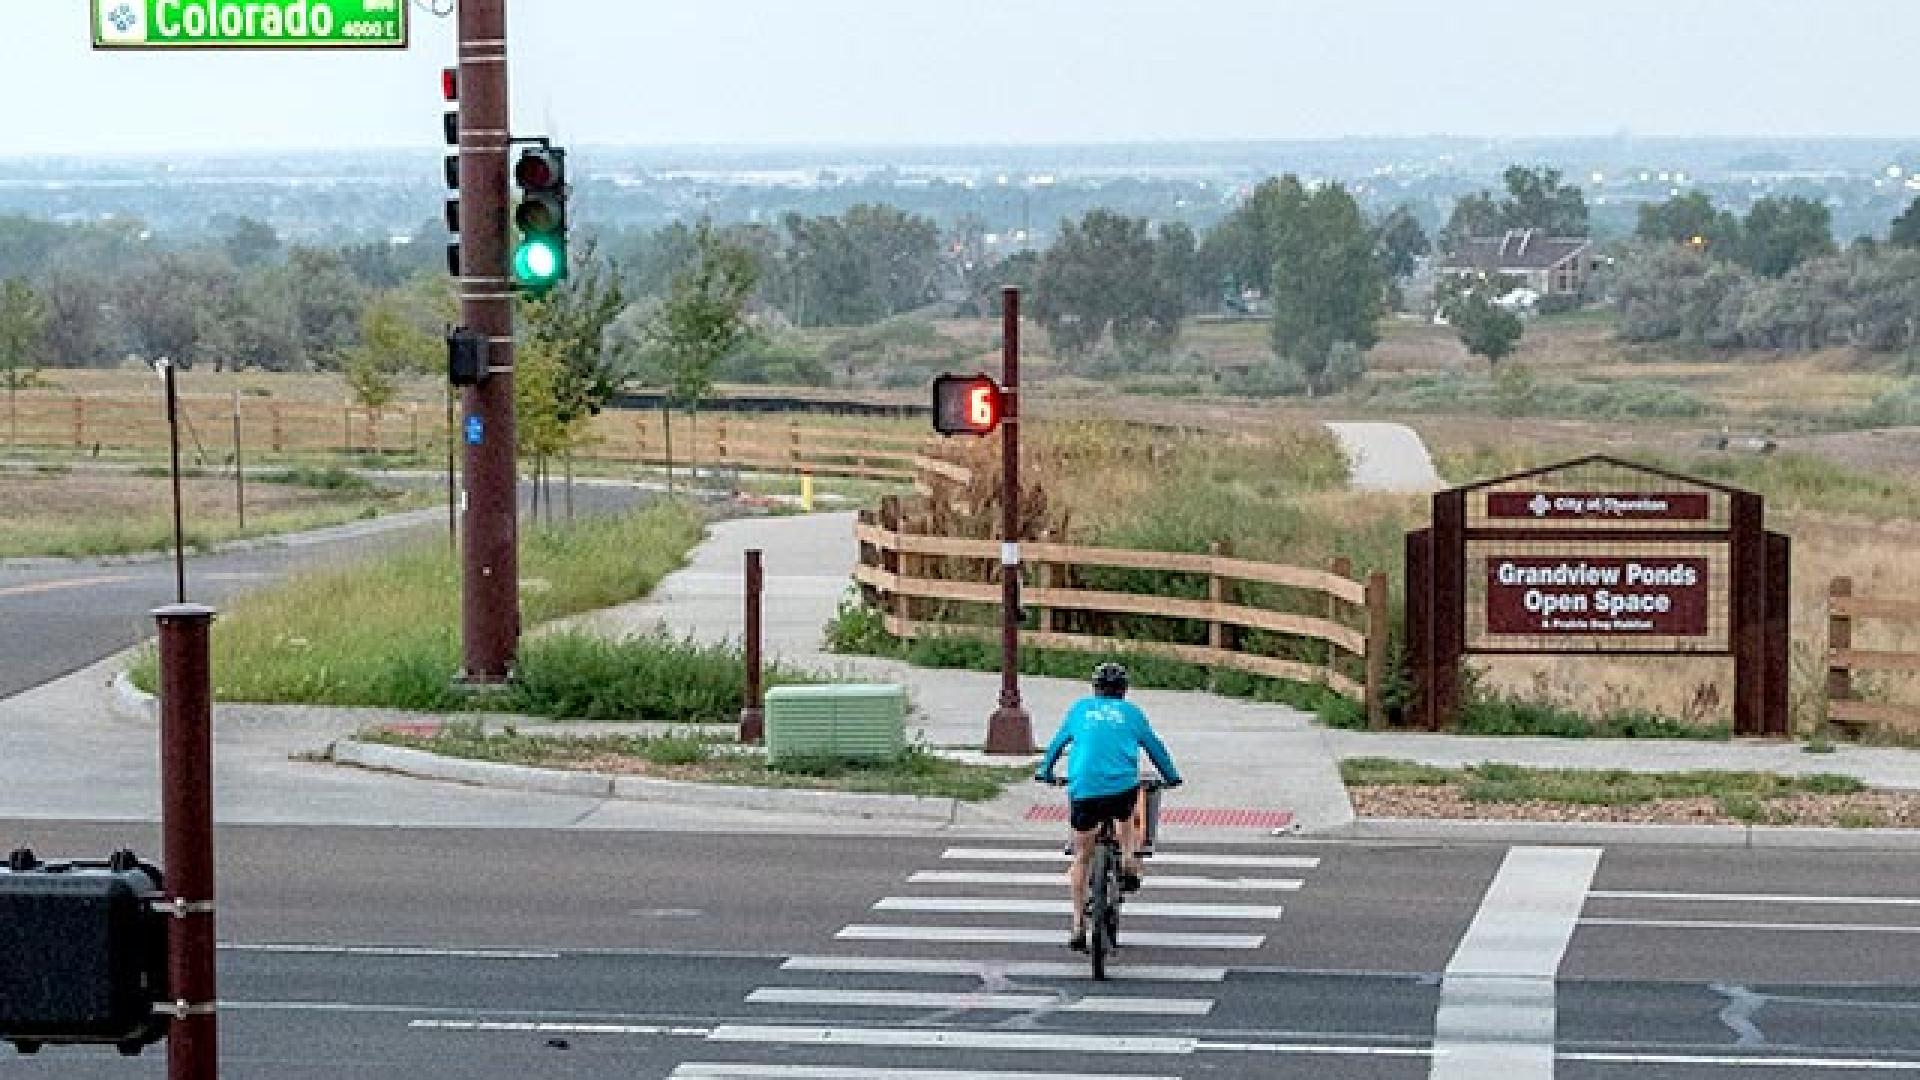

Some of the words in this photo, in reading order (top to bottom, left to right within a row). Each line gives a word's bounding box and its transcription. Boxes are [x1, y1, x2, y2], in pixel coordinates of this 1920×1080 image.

[155, 0, 333, 37] Colorado
[970, 387, 991, 423] 6
[1554, 497, 1582, 513] City
[1499, 563, 1620, 585] Grandview
[1627, 563, 1697, 585] Ponds
[1525, 590, 1587, 615] Open
[1595, 590, 1671, 615] Space
